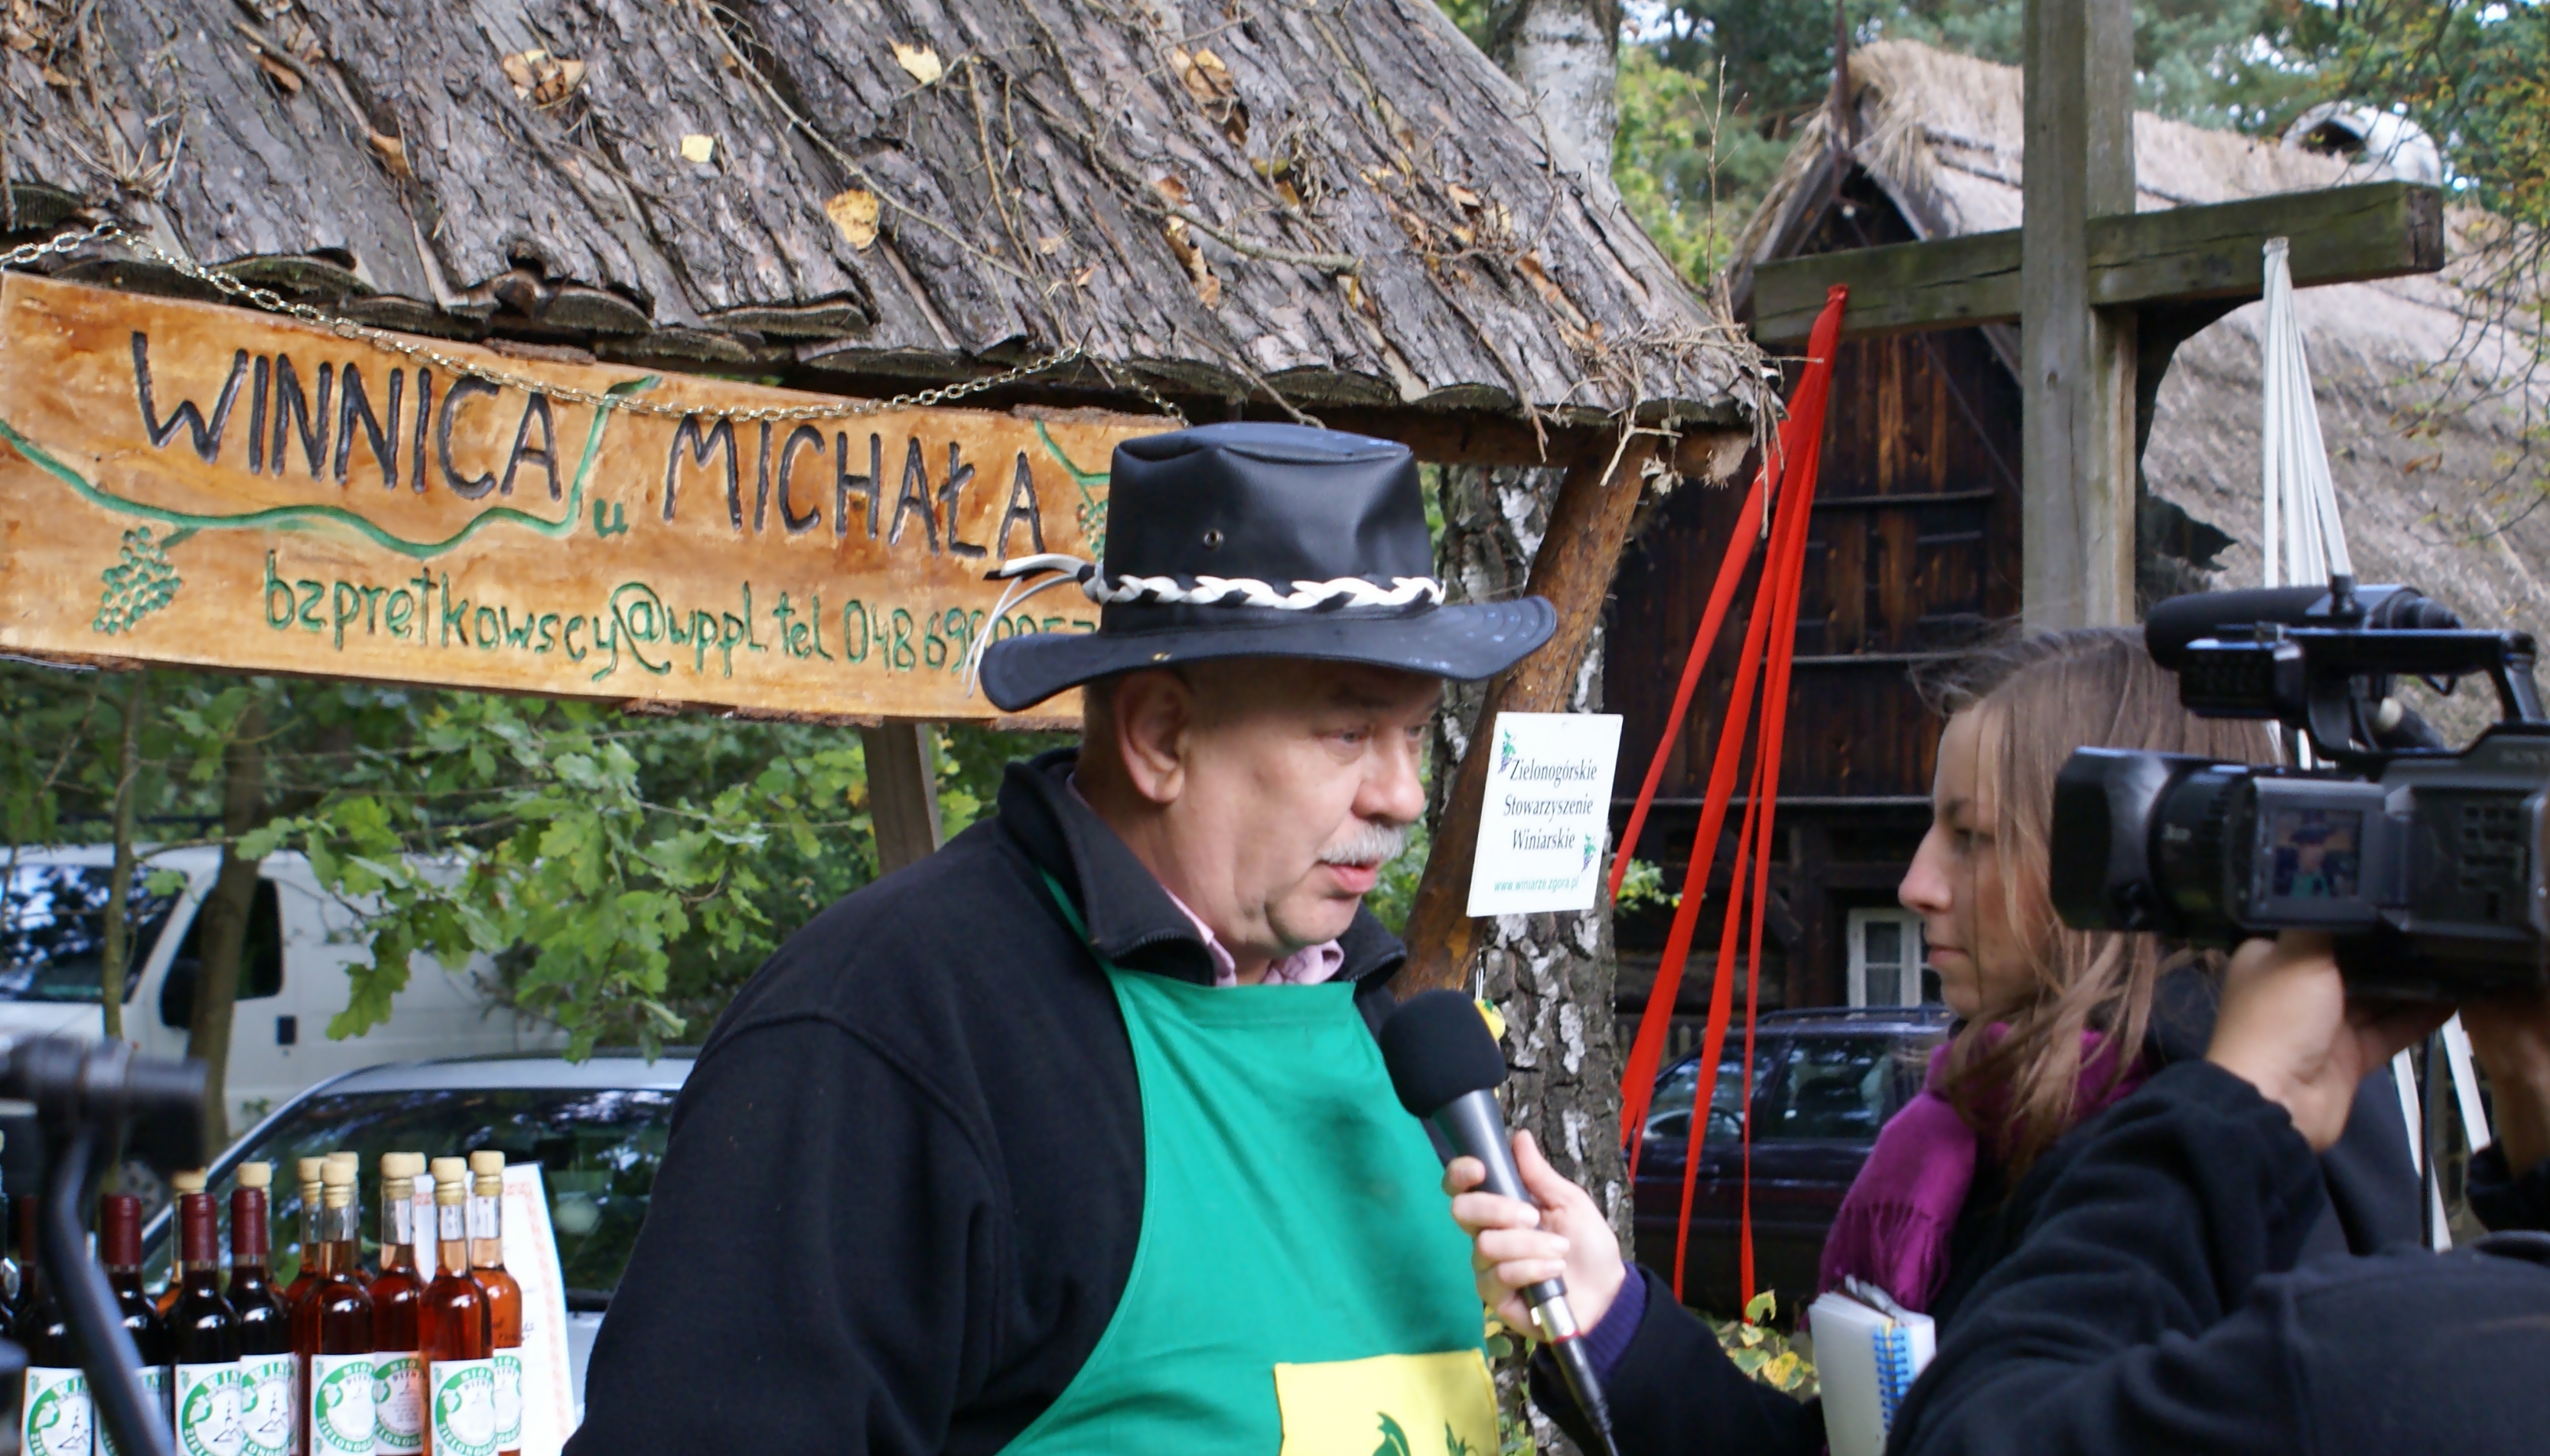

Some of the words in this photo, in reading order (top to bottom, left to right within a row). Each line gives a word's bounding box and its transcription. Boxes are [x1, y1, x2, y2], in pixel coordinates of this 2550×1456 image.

[132, 330, 562, 501] WINNICA
[663, 413, 1045, 558] MICHAŁA
[1509, 758, 1597, 788] Zielonogórskie
[1503, 793, 1594, 822] Stowarzyszenie
[1512, 827, 1575, 851] Winiarskie
